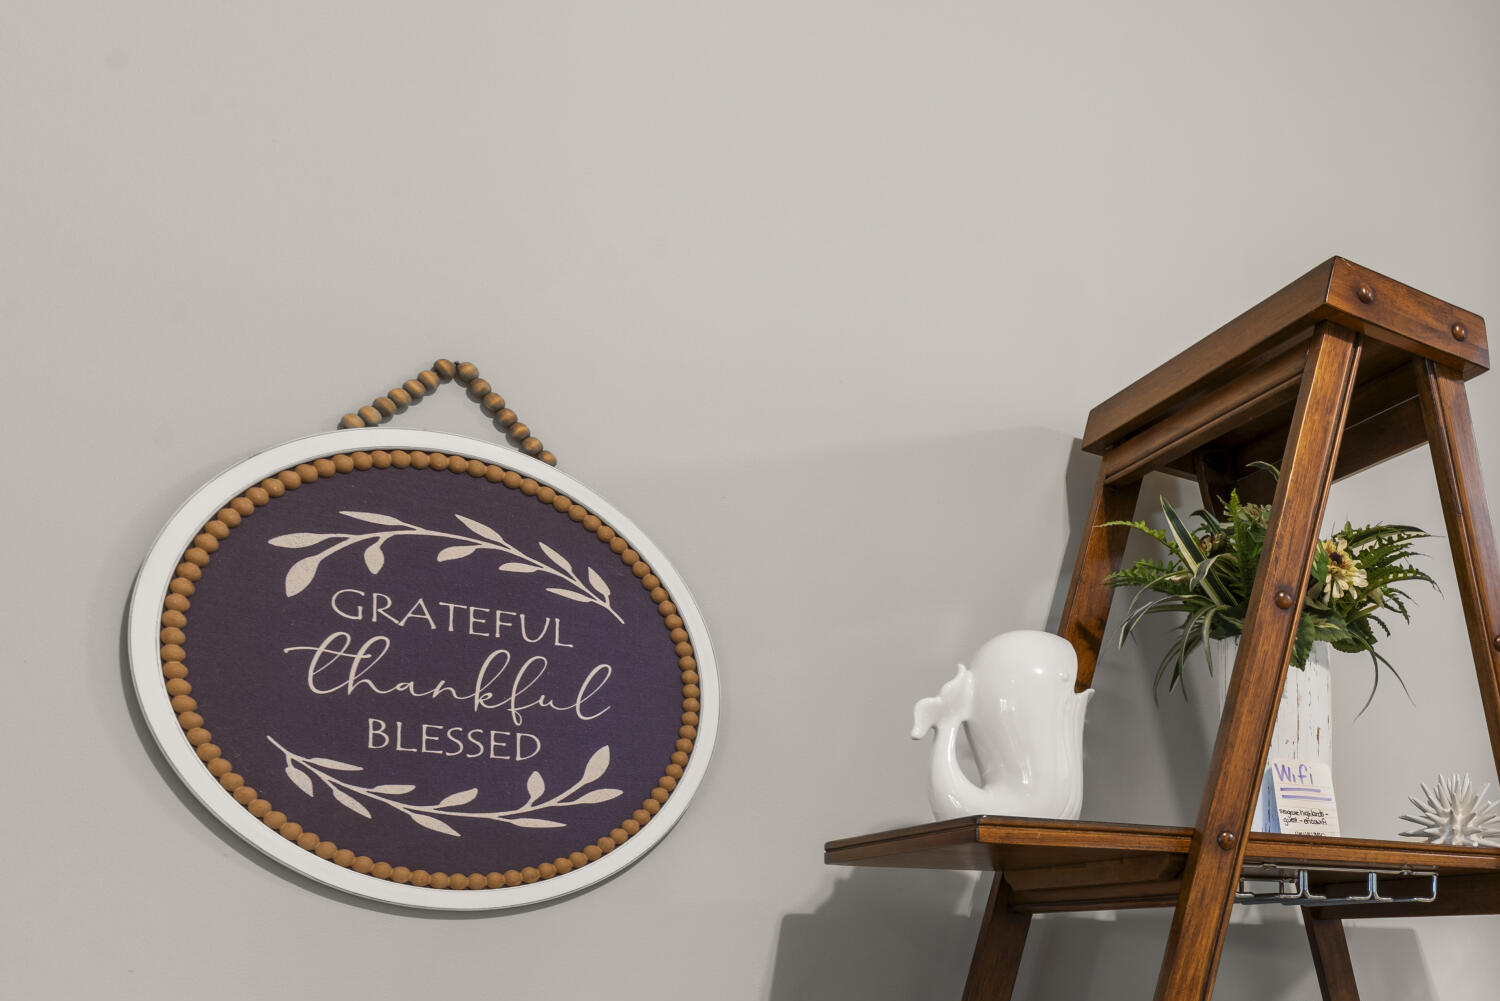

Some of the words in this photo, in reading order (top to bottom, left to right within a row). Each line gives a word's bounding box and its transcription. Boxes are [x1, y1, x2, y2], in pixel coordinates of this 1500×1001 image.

[331, 589, 573, 648] GRATEFUL
[283, 631, 612, 725] thankful
[368, 718, 541, 760] BLESSED
